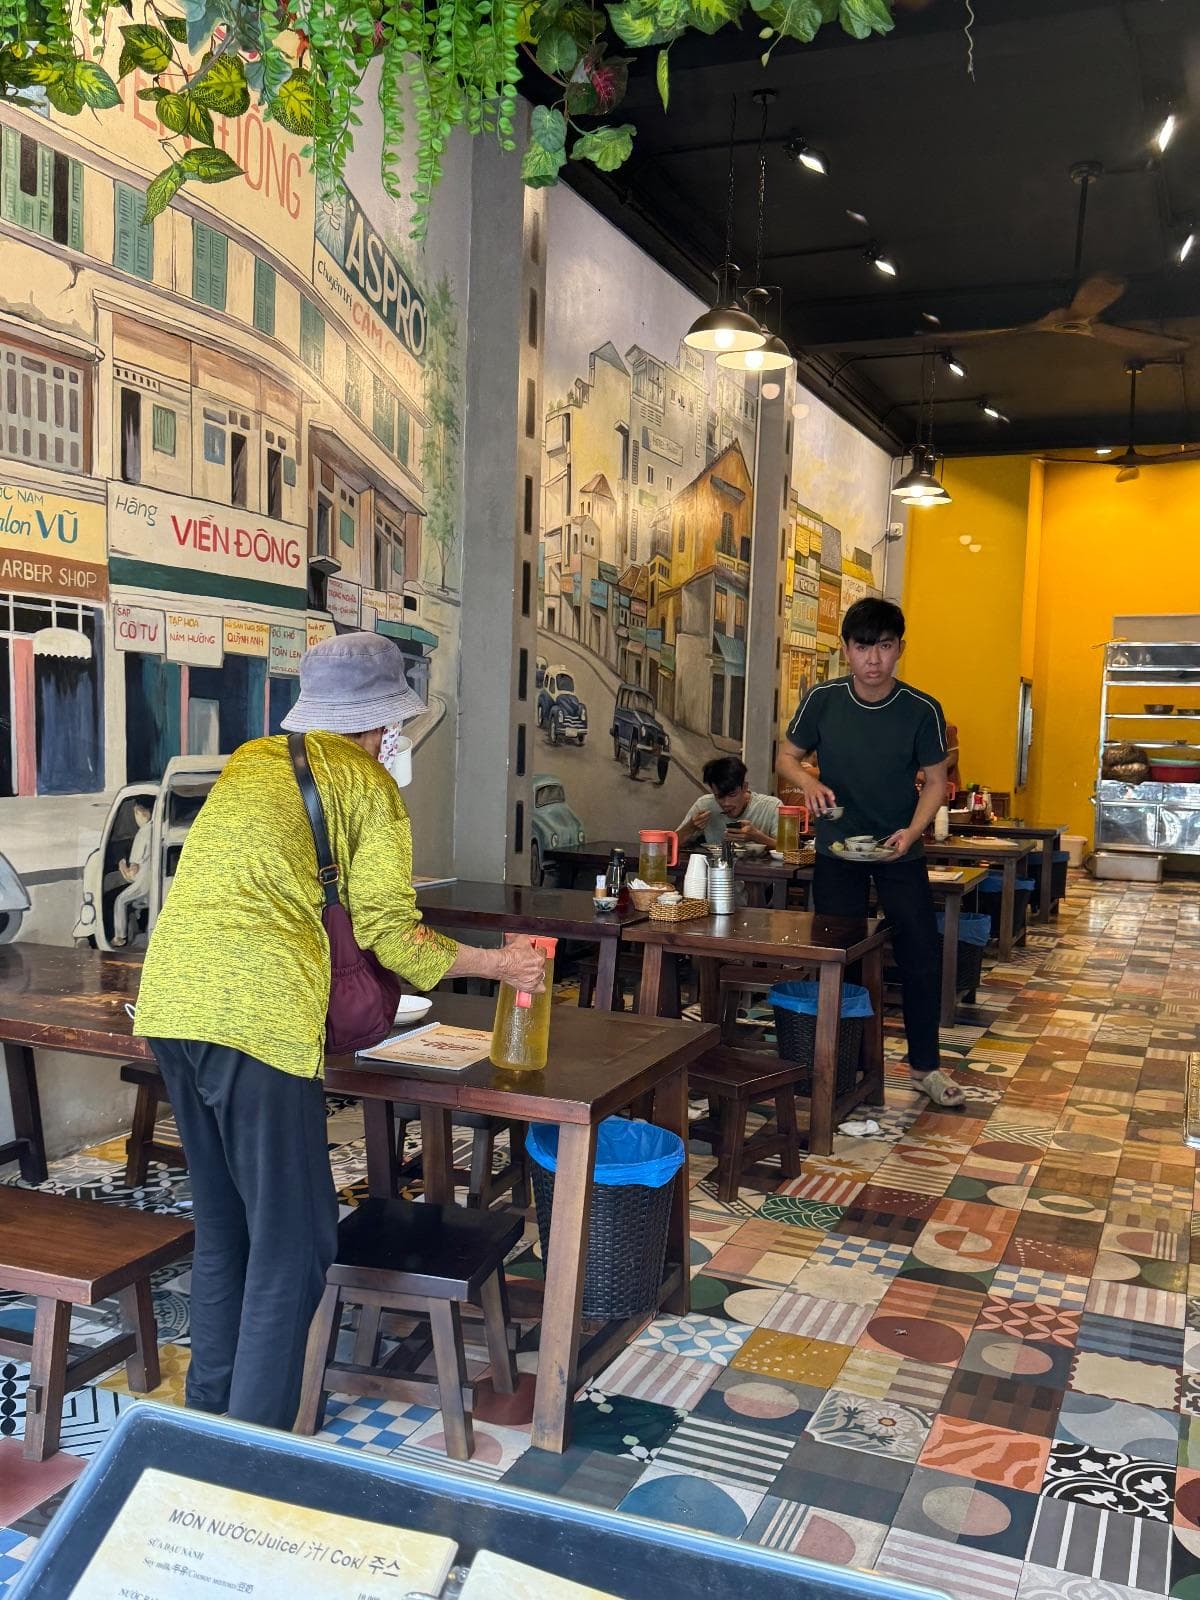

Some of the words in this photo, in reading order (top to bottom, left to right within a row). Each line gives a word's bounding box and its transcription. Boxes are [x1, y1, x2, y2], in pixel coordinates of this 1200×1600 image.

[18, 489, 44, 506] NAM
[35, 509, 78, 544] VŨ
[233, 528, 301, 568] ĐÔNG
[58, 567, 97, 588] SHOP
[168, 1509, 206, 1530] MÓN
[368, 1556, 400, 1577] 주스
